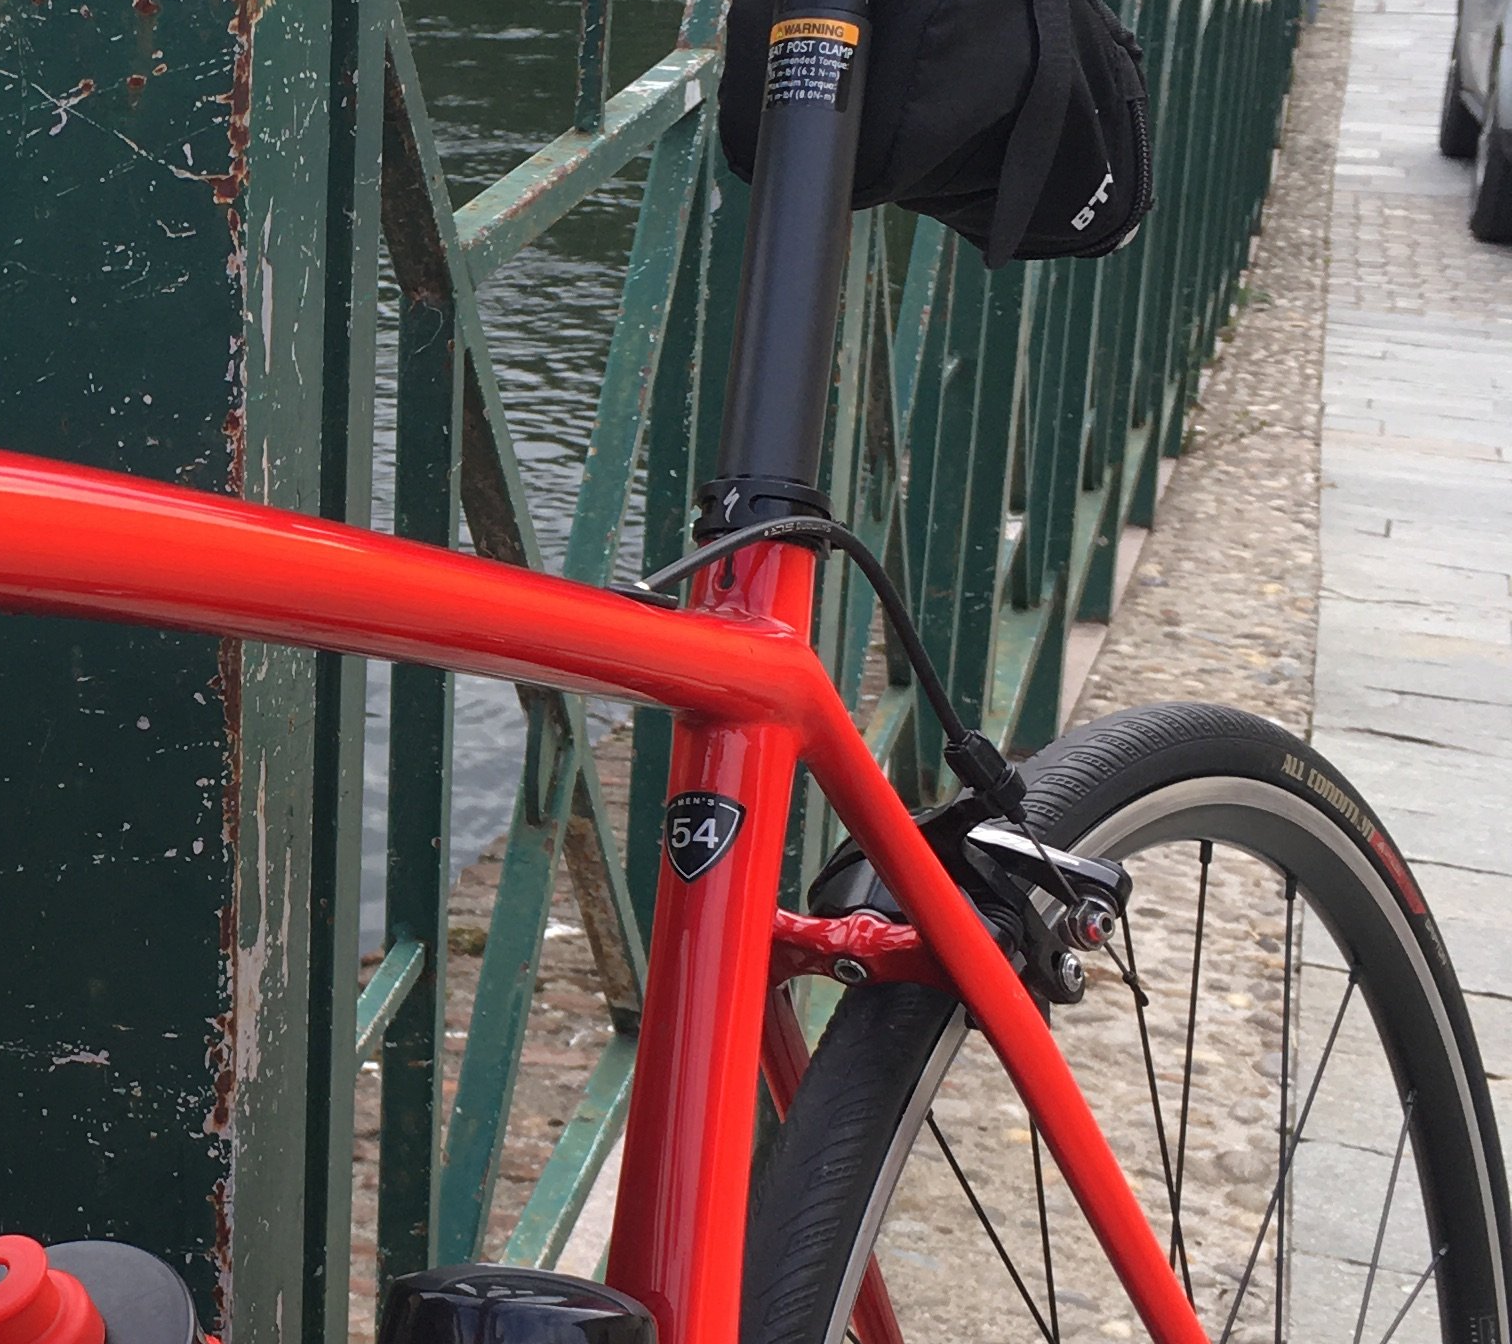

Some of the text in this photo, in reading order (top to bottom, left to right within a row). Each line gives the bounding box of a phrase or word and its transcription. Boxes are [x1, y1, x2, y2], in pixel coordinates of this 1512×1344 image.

[784, 22, 845, 38] WARNING
[786, 40, 816, 54] POST
[818, 42, 854, 59] CLAMP
[1281, 754, 1305, 782] ALL
[671, 817, 719, 849] 54
